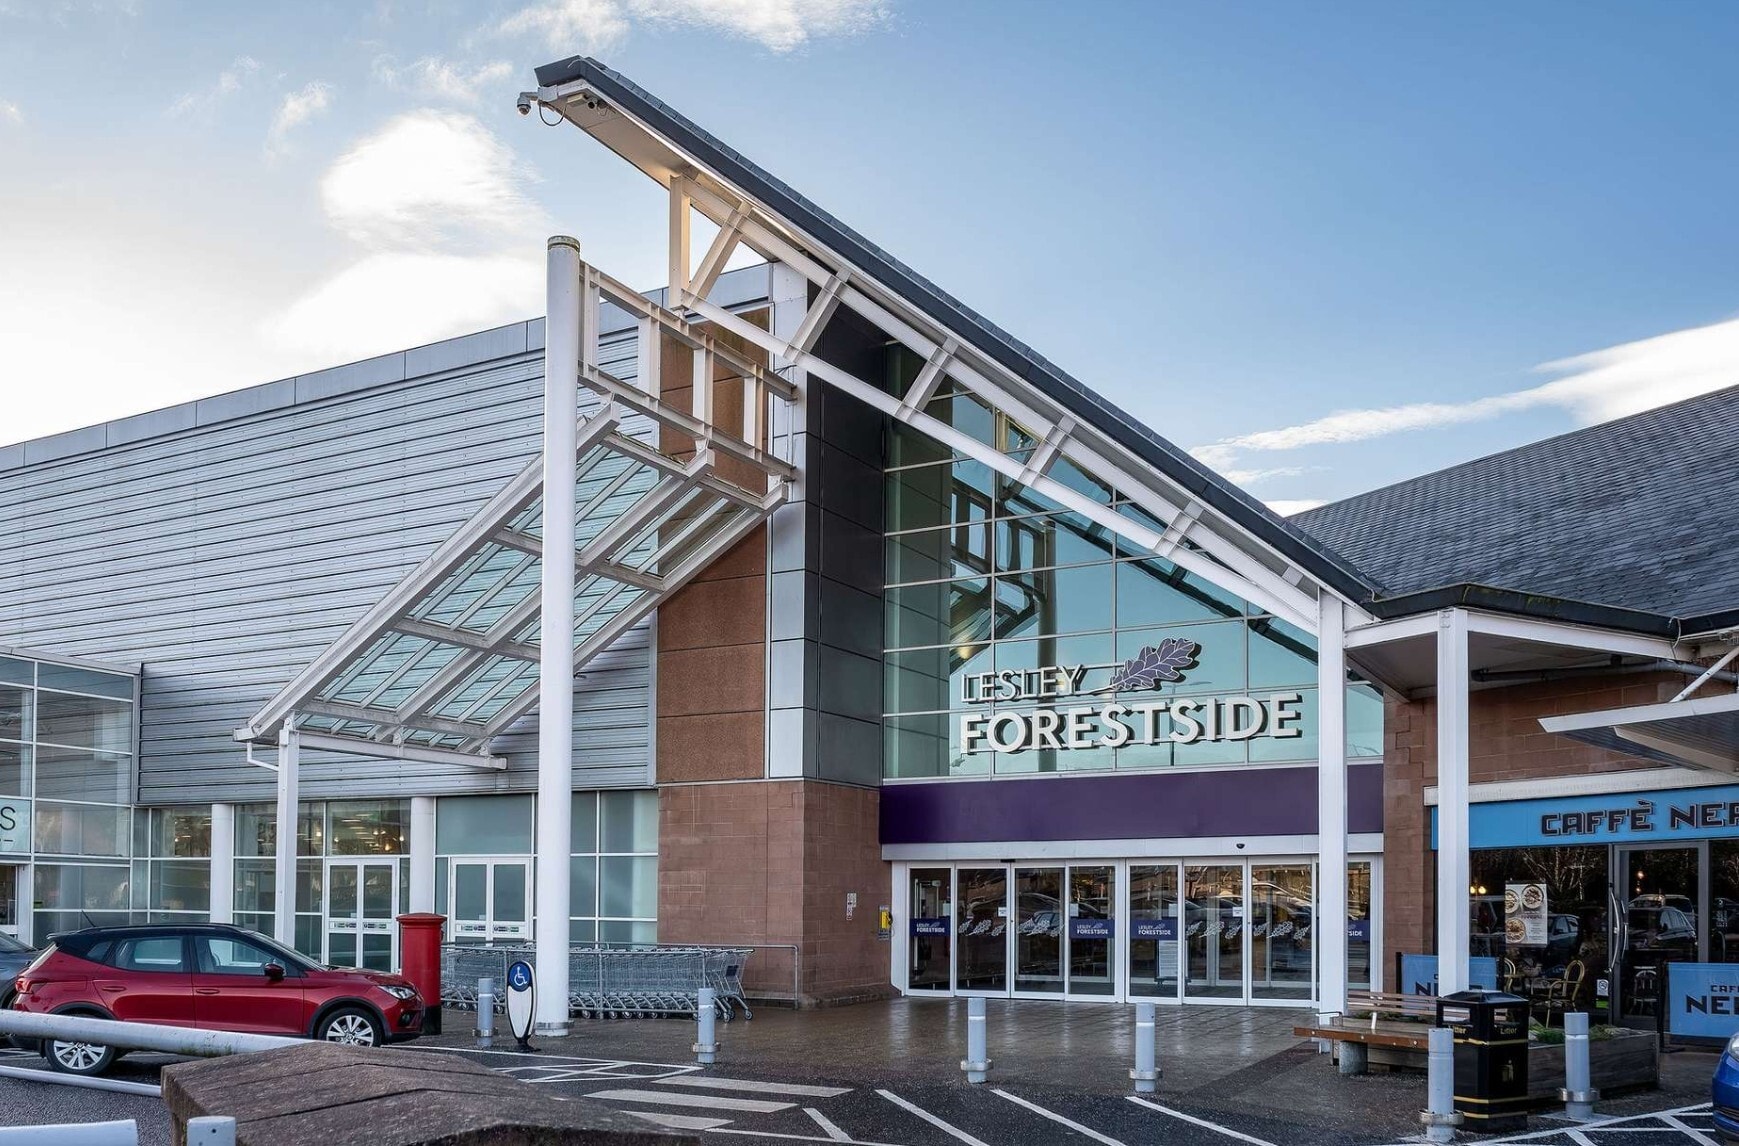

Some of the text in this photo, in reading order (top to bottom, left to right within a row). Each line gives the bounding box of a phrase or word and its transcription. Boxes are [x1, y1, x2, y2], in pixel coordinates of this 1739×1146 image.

[961, 663, 1085, 703] LESLEY
[960, 692, 1302, 755] FORESTSIDE
[1541, 799, 1653, 836] CAFFÈ
[1710, 984, 1739, 993] CAF
